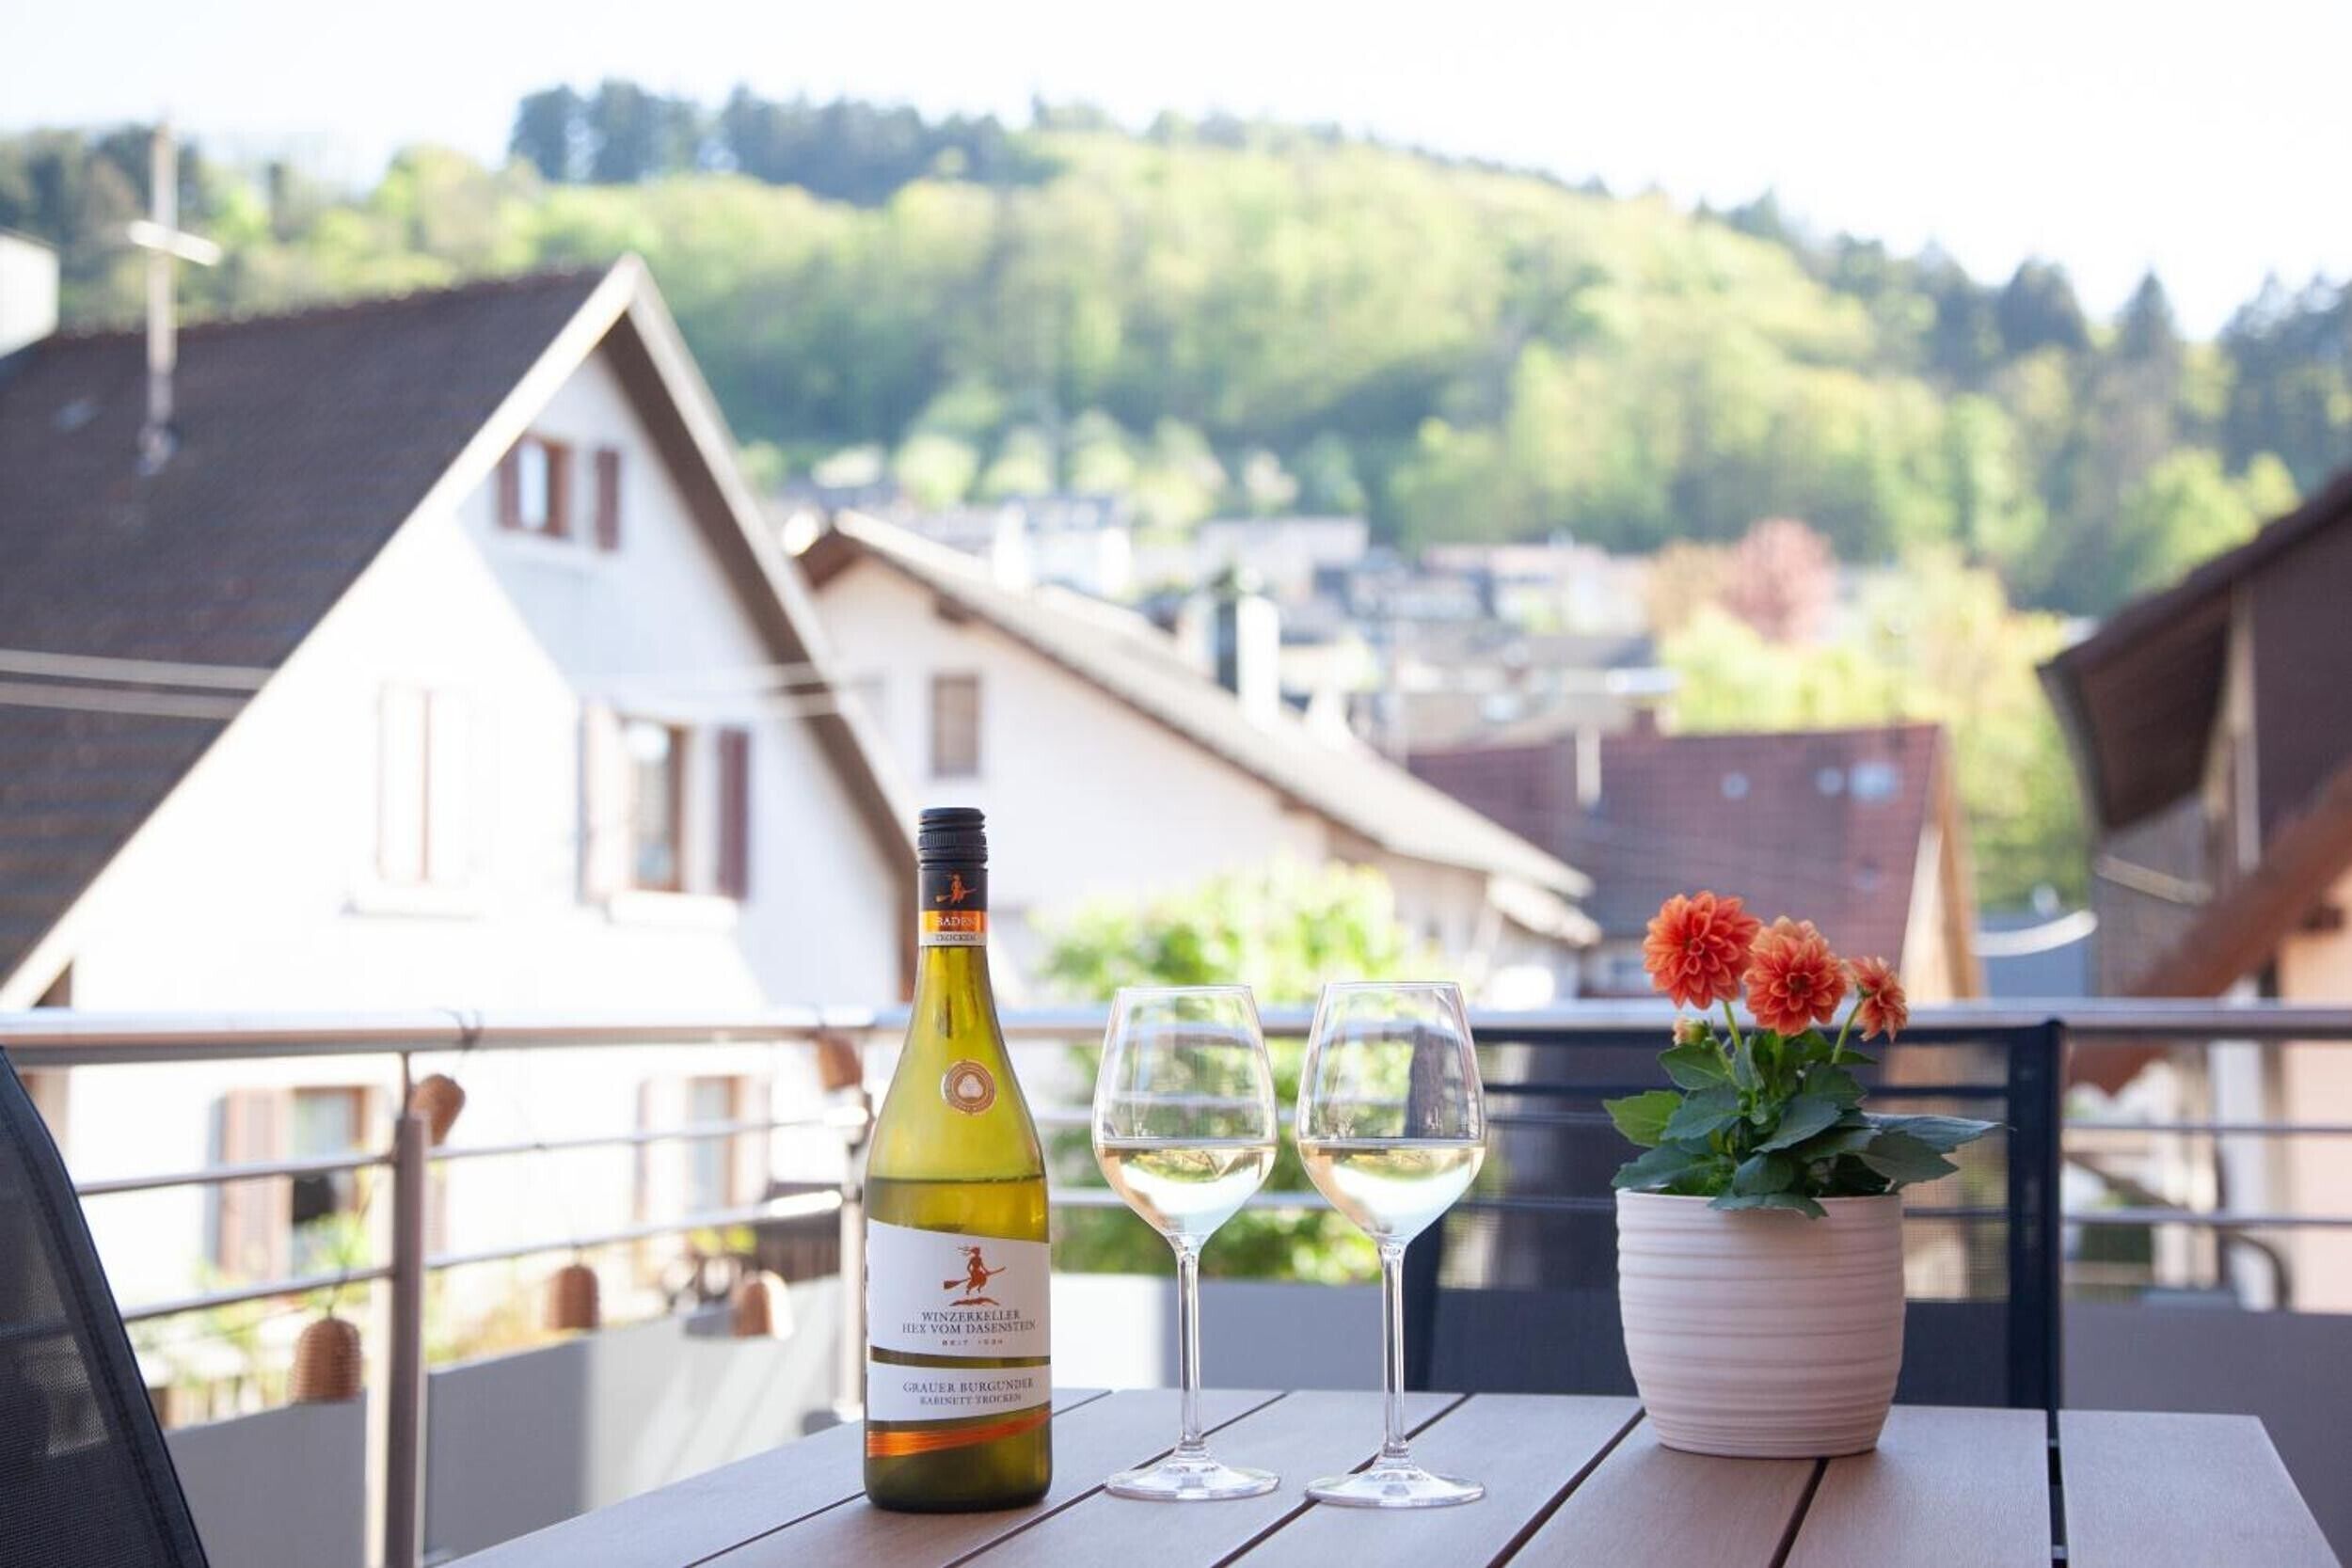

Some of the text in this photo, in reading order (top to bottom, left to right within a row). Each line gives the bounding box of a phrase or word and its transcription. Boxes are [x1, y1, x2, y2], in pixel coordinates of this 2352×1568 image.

[922, 1310, 1021, 1322] WINZERKELLER
[902, 1320, 1036, 1335] HEX VOM DASENSTEIN
[902, 1377, 1034, 1393] GRAUER BURGUNDER
[919, 1392, 1022, 1405] KABINETT TROCKEN
